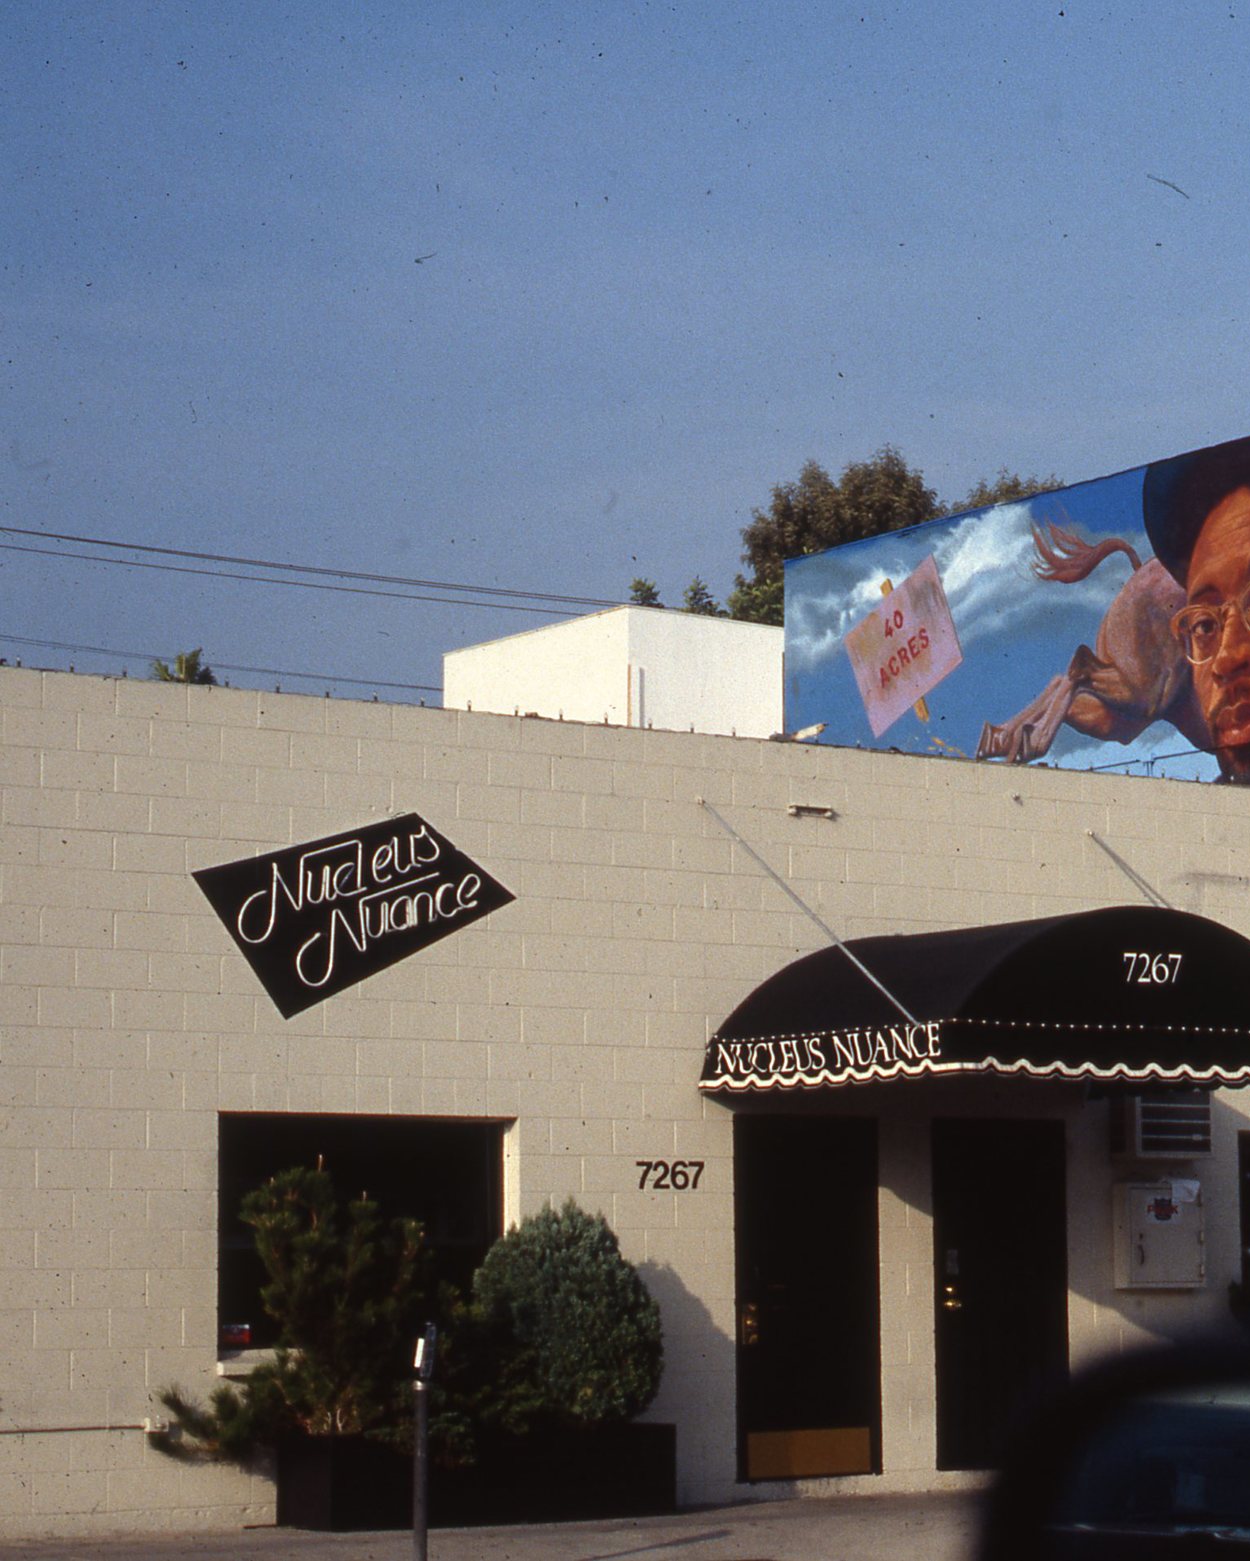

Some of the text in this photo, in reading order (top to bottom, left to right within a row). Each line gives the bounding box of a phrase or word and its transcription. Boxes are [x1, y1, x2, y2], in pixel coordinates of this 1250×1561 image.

[884, 610, 904, 639] 40
[879, 627, 929, 689] ACRES
[238, 825, 440, 944] Nucleus
[296, 873, 481, 987] Nuance
[1123, 952, 1182, 983] 7267
[714, 1023, 942, 1074] NUCLEUS NUANCE
[635, 1160, 705, 1190] 7267
